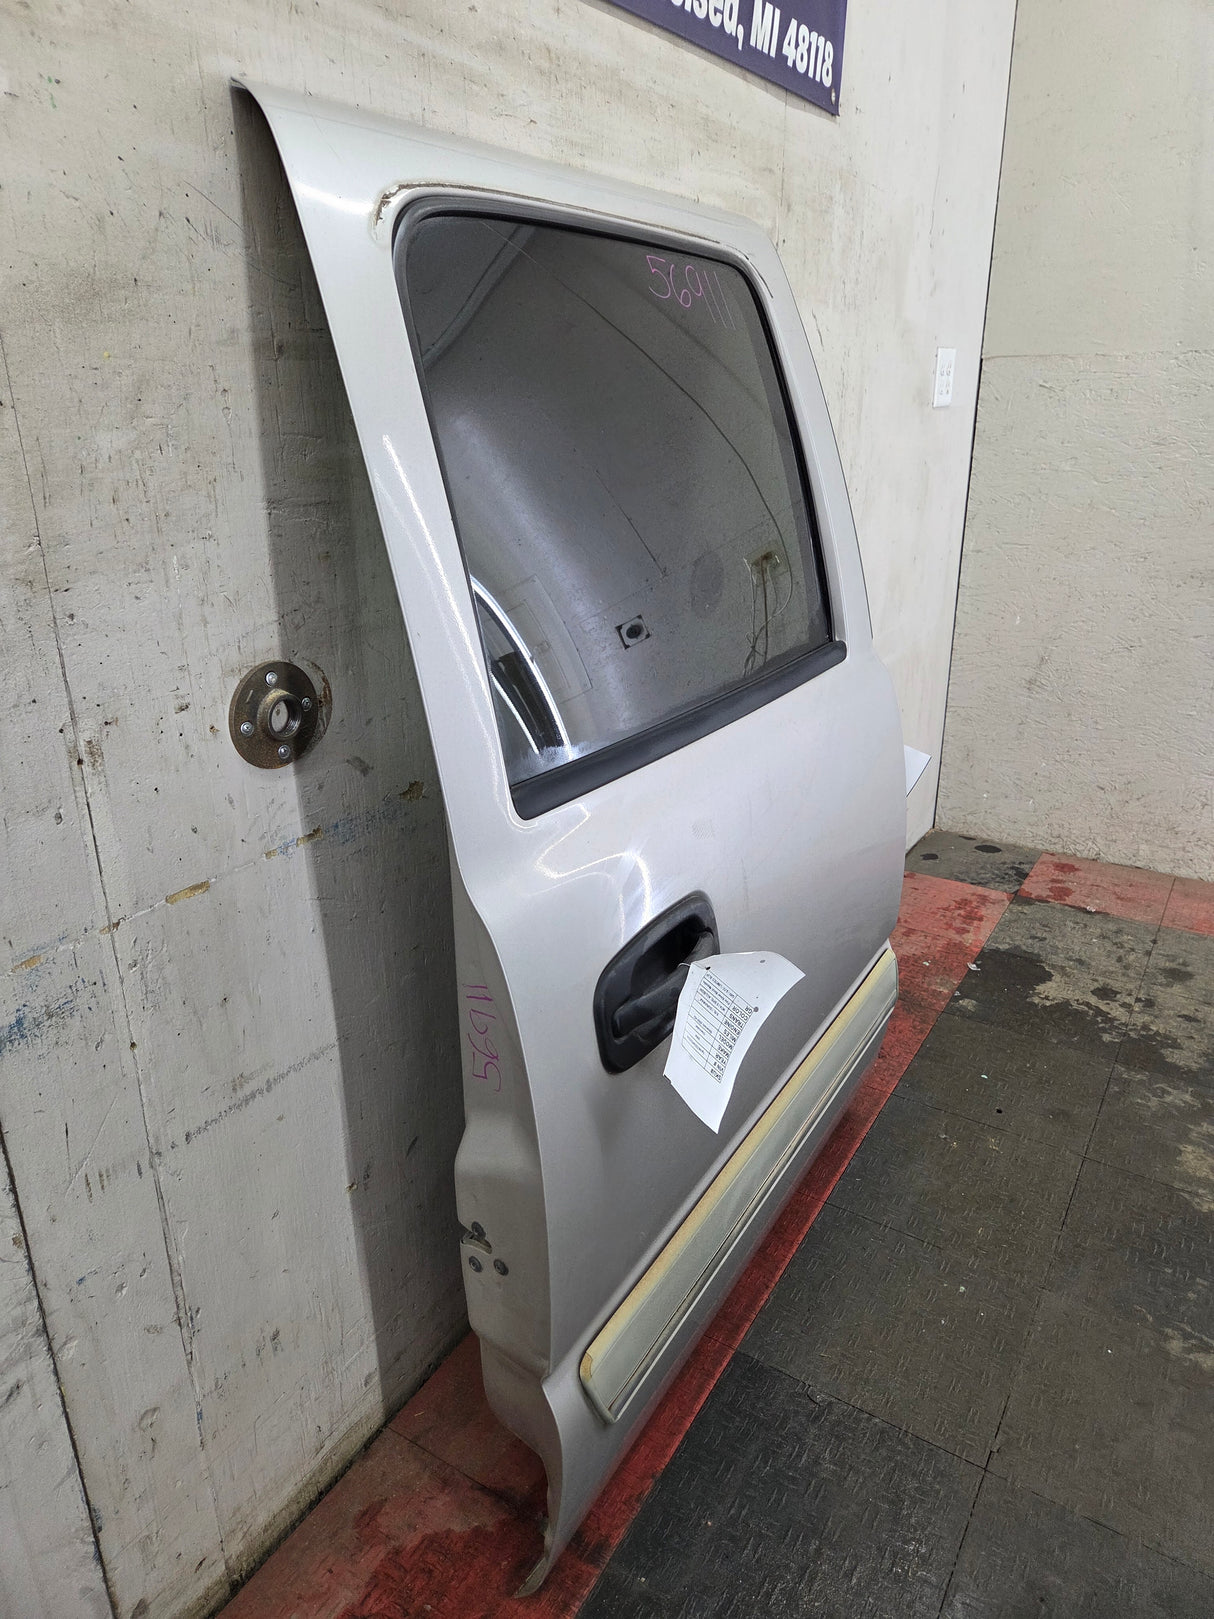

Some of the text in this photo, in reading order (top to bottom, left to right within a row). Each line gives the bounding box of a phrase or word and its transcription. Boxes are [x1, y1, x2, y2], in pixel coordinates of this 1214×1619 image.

[749, 0, 781, 58] MI
[782, 17, 834, 88] 48118
[646, 255, 737, 331] 56911
[729, 1013, 744, 1028] TRANS
[731, 1005, 748, 1021] COLOR
[723, 1028, 737, 1043] MILES
[724, 1019, 740, 1036] ENGINE
[461, 983, 502, 1093] 56911
[719, 1034, 733, 1050] MODEL
